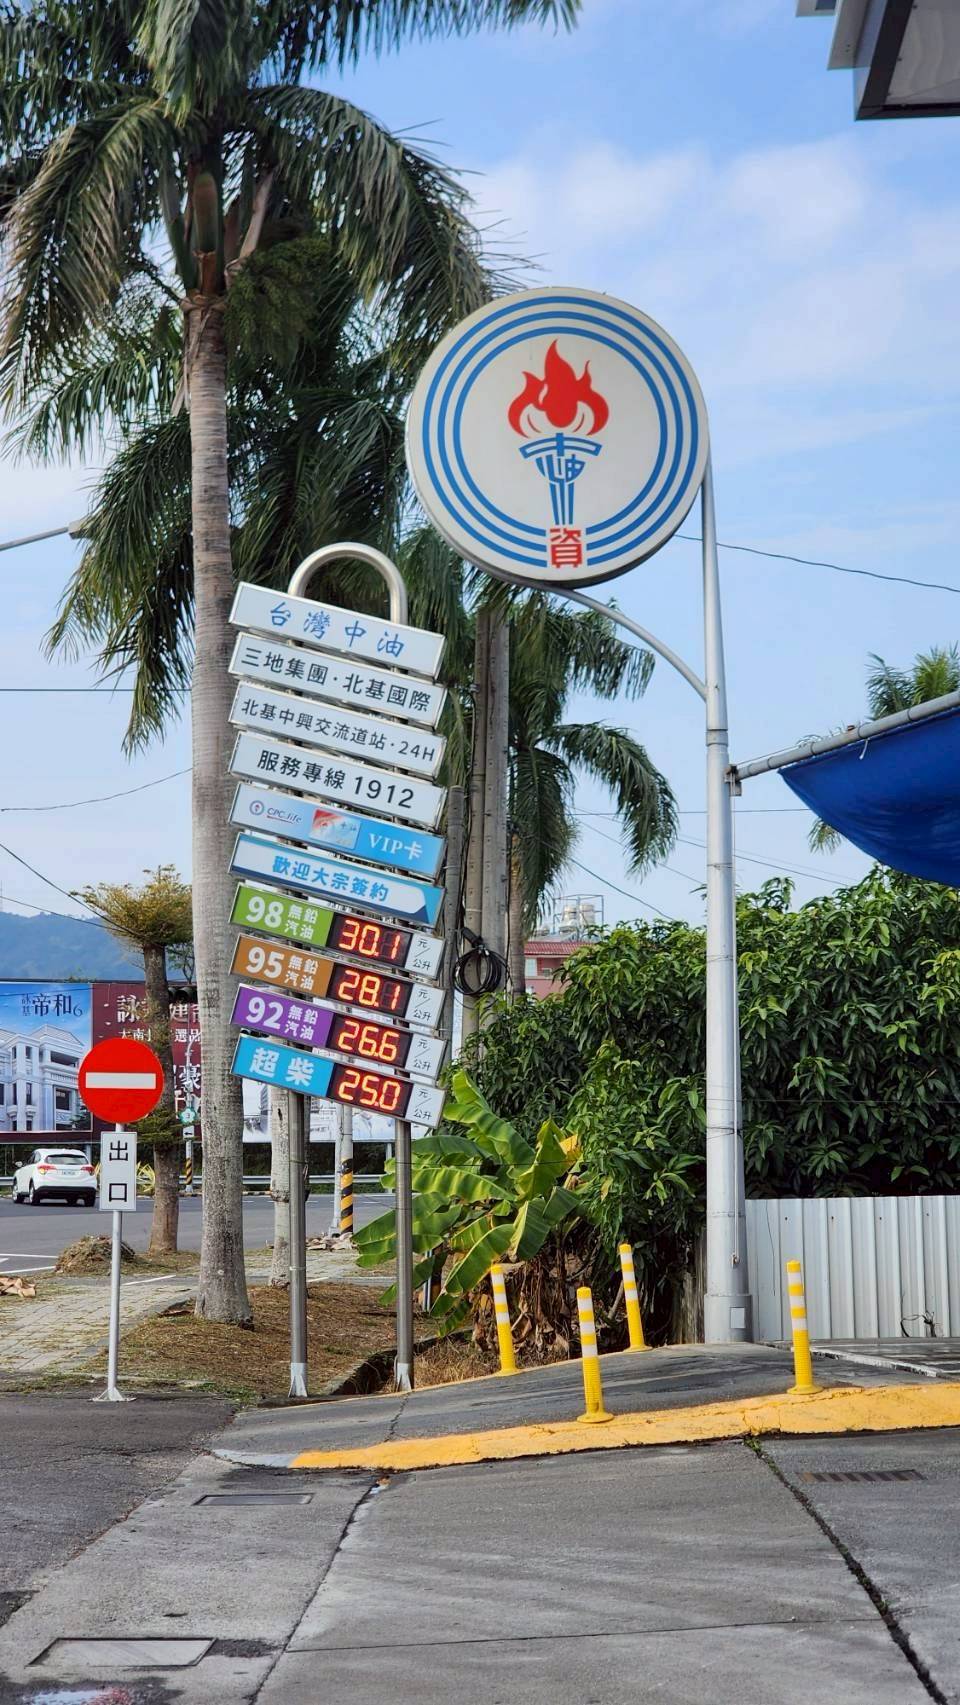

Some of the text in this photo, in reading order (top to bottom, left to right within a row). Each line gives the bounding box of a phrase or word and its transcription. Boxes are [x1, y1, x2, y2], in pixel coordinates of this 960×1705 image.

[550, 528, 583, 569] 資
[270, 602, 405, 658] 台灣中油
[257, 749, 414, 809] 服務專線 1912
[369, 832, 423, 860] VIP卡
[272, 855, 389, 902] 歡迎大宗簽約
[246, 896, 284, 928] 98
[284, 919, 314, 940] 汽油
[287, 904, 319, 925] 無鉛
[338, 919, 400, 960] 30.1
[246, 947, 284, 978] 95
[284, 970, 314, 991] 汽油
[287, 955, 319, 976] 無鉛
[338, 969, 400, 1010] 28.1
[245, 997, 284, 1030] 92
[284, 1020, 314, 1040] 汽油
[287, 1005, 319, 1025] 無鉛
[338, 1020, 400, 1062] 26.6
[248, 1047, 315, 1087] 超柴
[337, 1069, 401, 1111] 25.0
[108, 1140, 129, 1203] 出口
